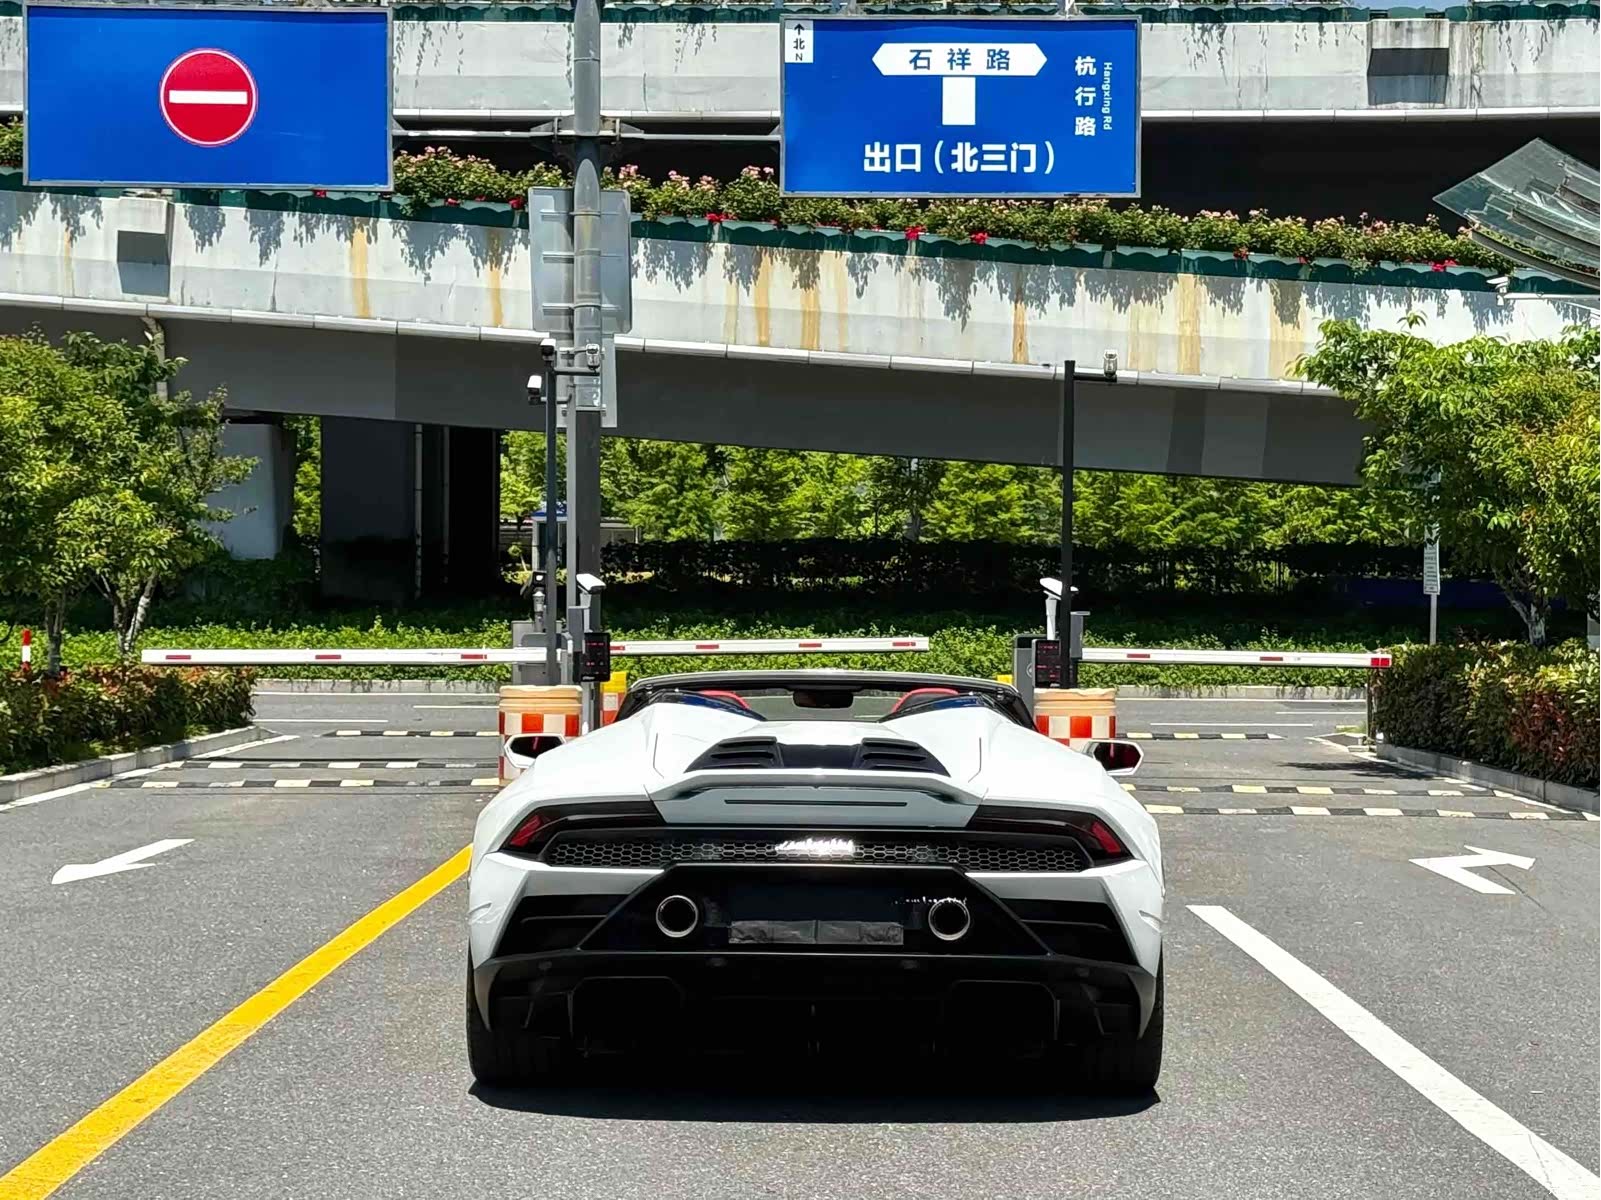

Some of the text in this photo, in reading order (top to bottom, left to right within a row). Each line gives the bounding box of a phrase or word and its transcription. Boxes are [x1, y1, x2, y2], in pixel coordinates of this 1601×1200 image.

[793, 38, 805, 50] 北
[795, 53, 803, 61] N
[909, 48, 1010, 71] 石祥路
[1075, 55, 1097, 136] 杭行路
[1102, 62, 1113, 130] Hangxing Rd
